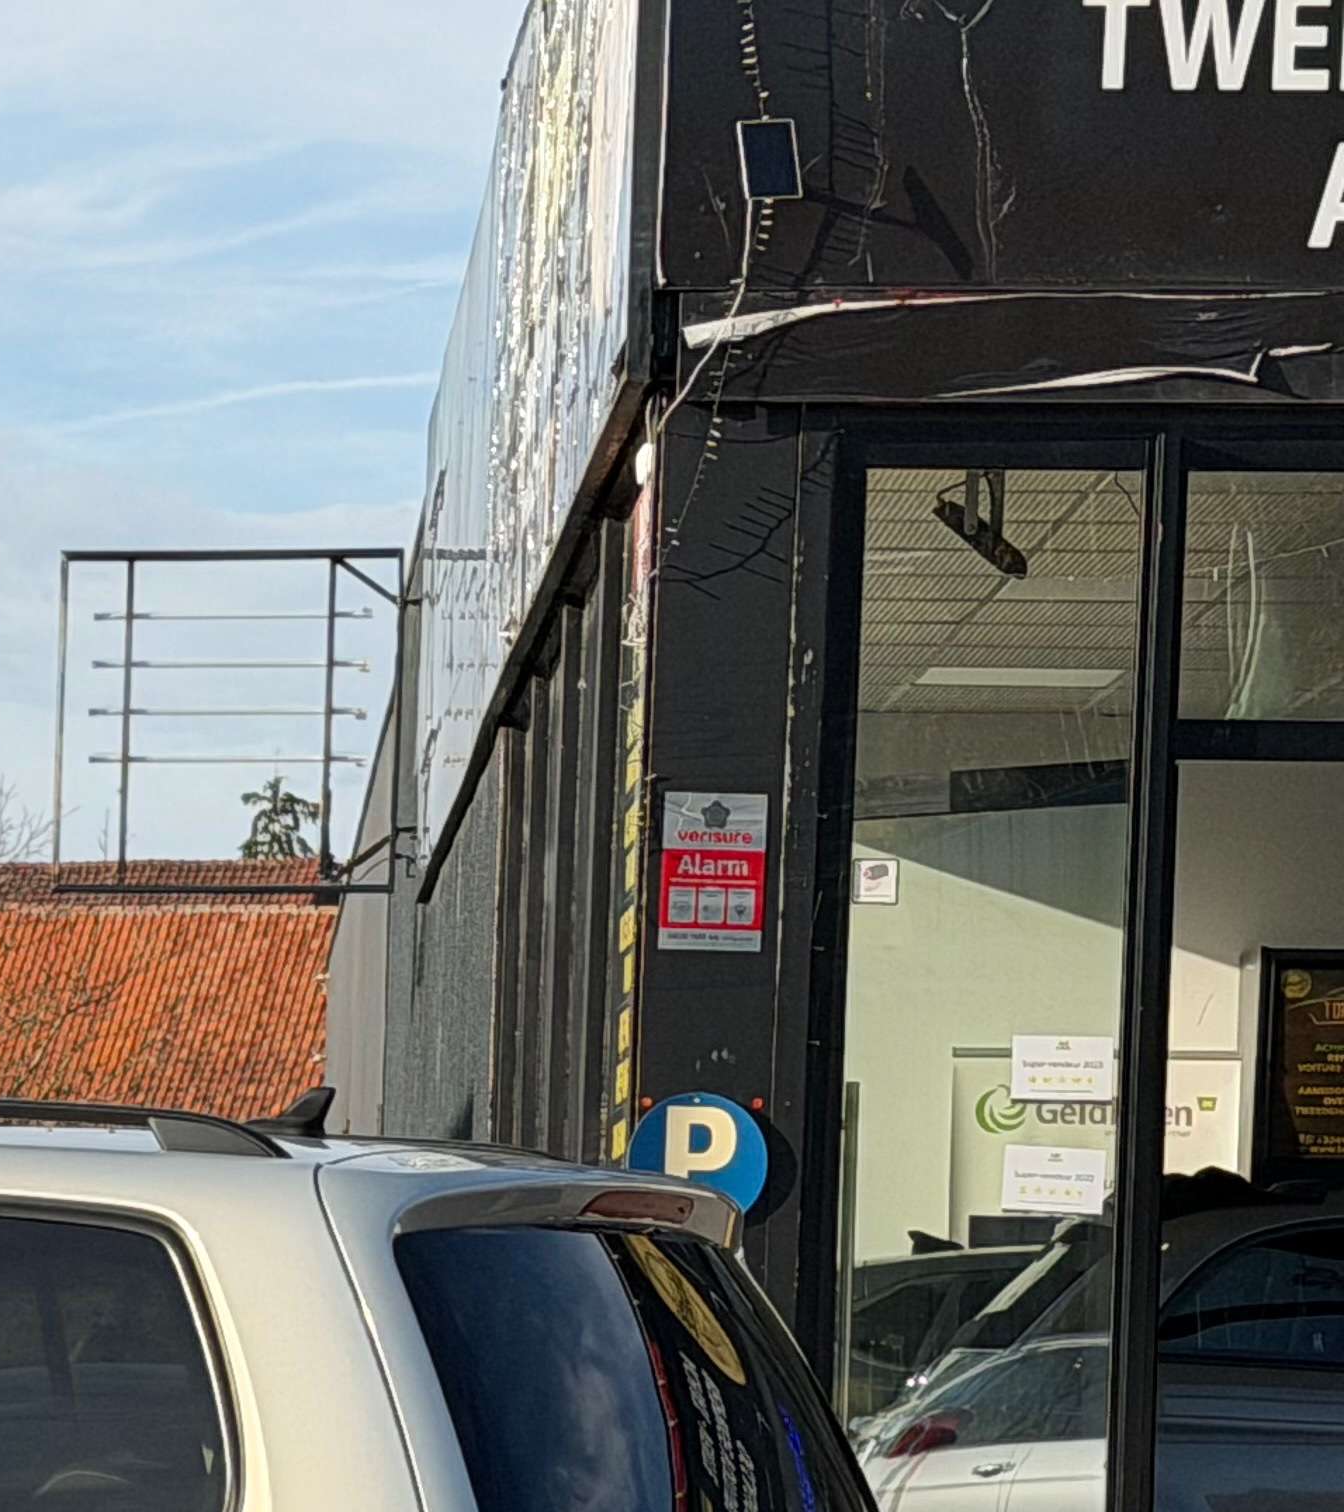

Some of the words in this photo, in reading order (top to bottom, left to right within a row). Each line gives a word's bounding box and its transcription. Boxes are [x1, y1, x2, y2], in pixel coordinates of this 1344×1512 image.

[1082, 0, 1344, 91] TWE
[677, 830, 753, 845] verisure
[677, 853, 749, 877] Alarm
[664, 1105, 738, 1179] P
